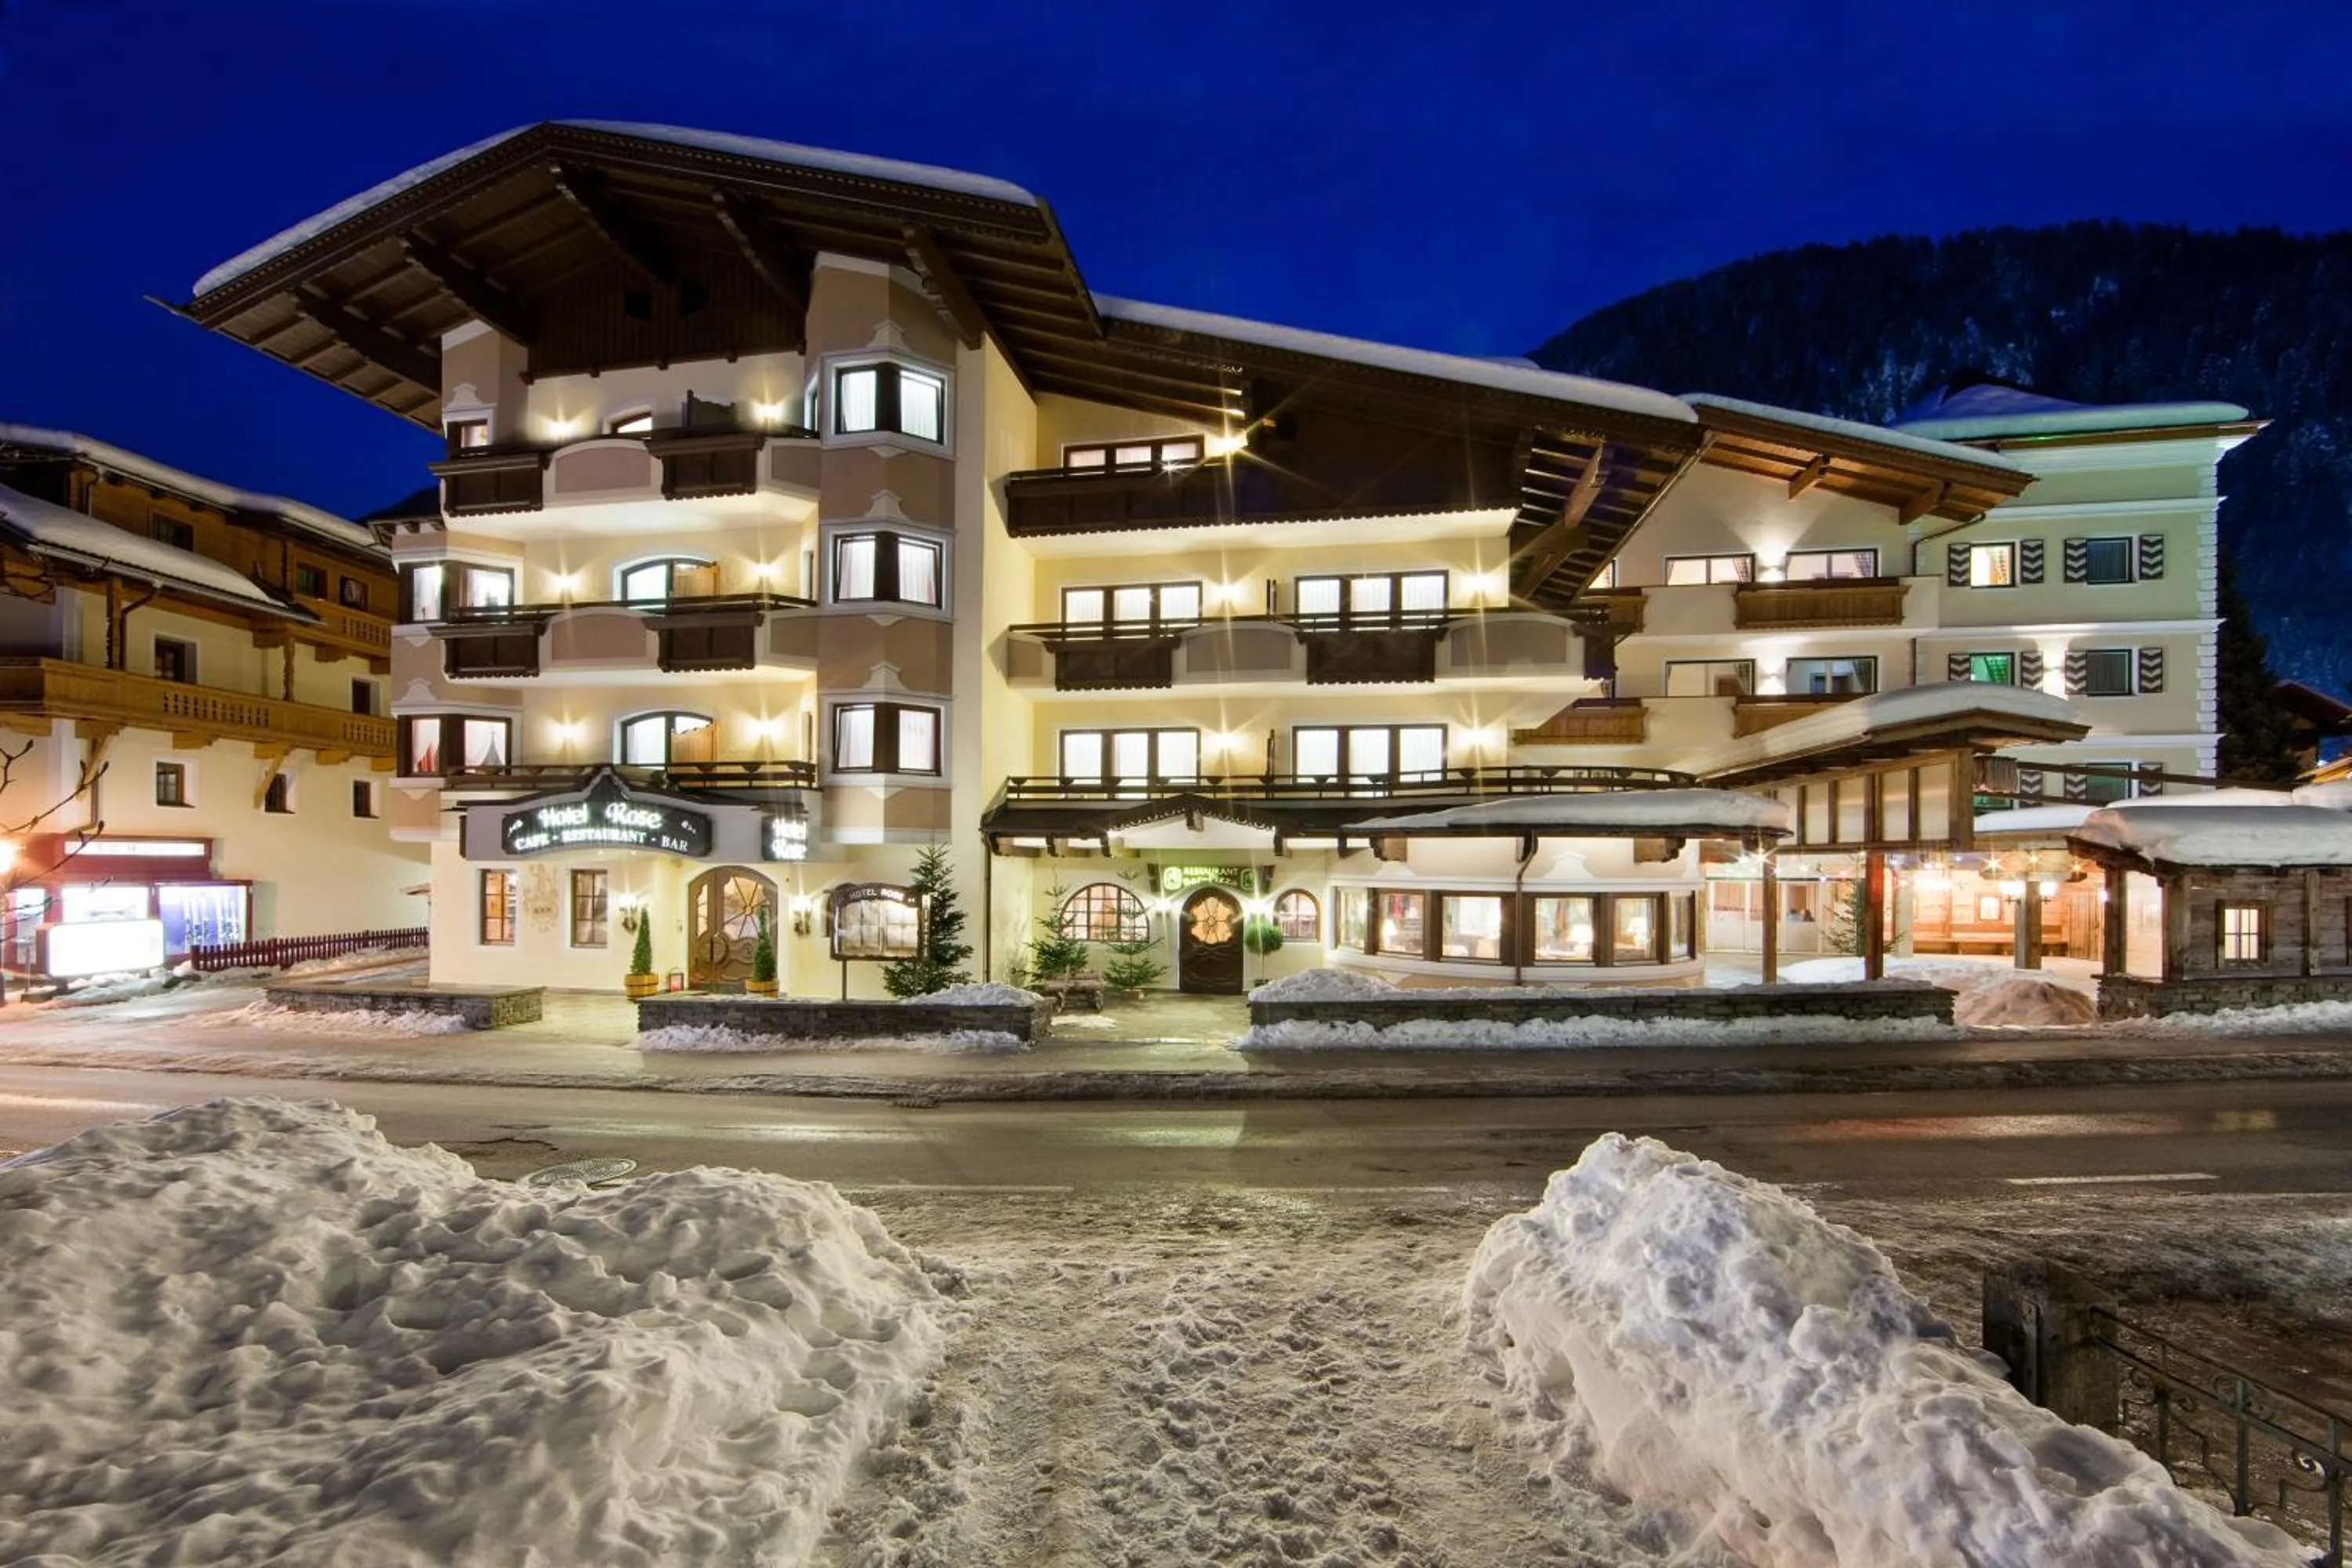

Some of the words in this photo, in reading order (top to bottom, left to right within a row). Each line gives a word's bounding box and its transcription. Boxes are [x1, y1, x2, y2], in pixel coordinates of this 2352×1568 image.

[538, 803, 588, 827] Hotel
[604, 802, 663, 829] Rose
[561, 828, 647, 843] RESTAURANT
[661, 836, 688, 852] BAR
